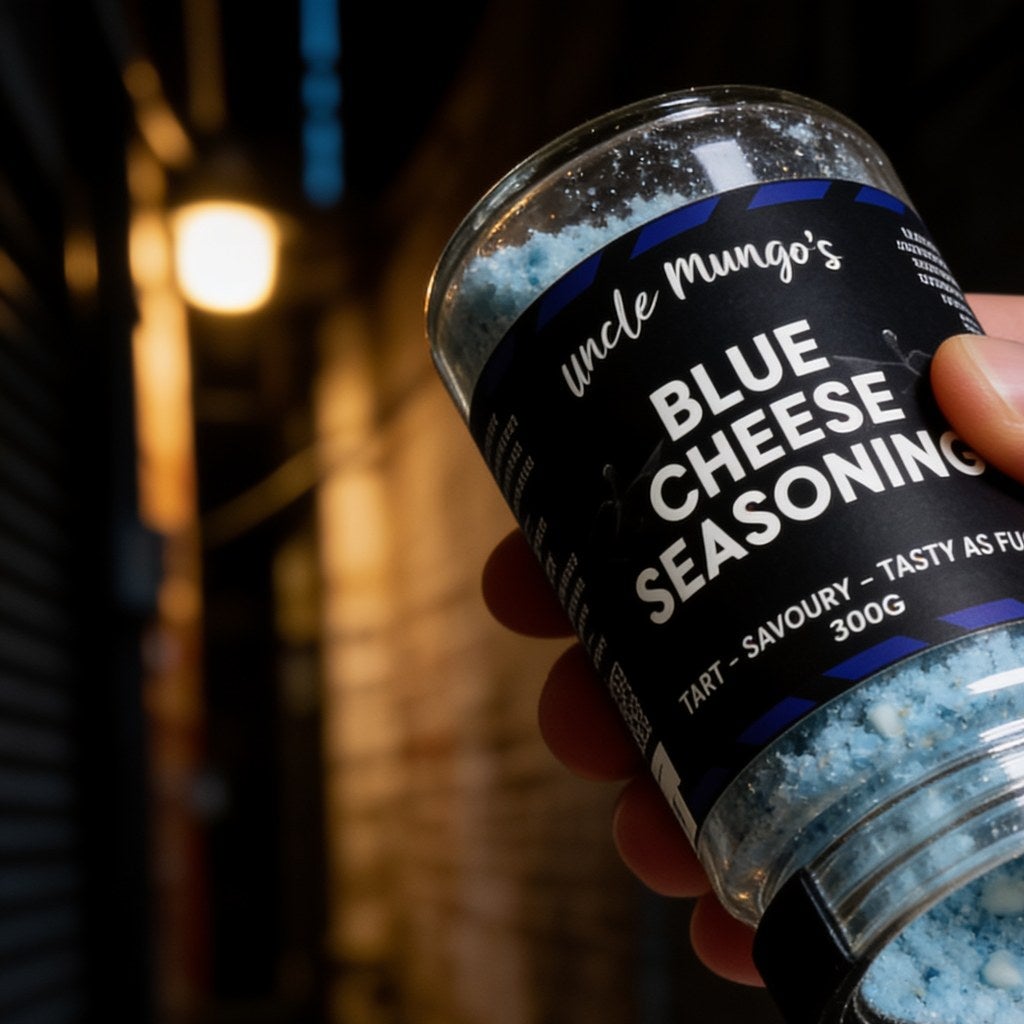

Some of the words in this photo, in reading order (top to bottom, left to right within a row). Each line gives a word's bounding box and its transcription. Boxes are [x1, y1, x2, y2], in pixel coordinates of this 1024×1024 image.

[663, 229, 844, 301] Mungo's
[649, 318, 832, 442] BLUE
[649, 370, 907, 522] CHEESE
[636, 429, 986, 624] SEASONING
[679, 660, 724, 715] TART
[742, 576, 851, 659] SAVOURY
[875, 538, 956, 582] TASTY
[963, 532, 995, 559] AS
[828, 593, 907, 642] 300G
